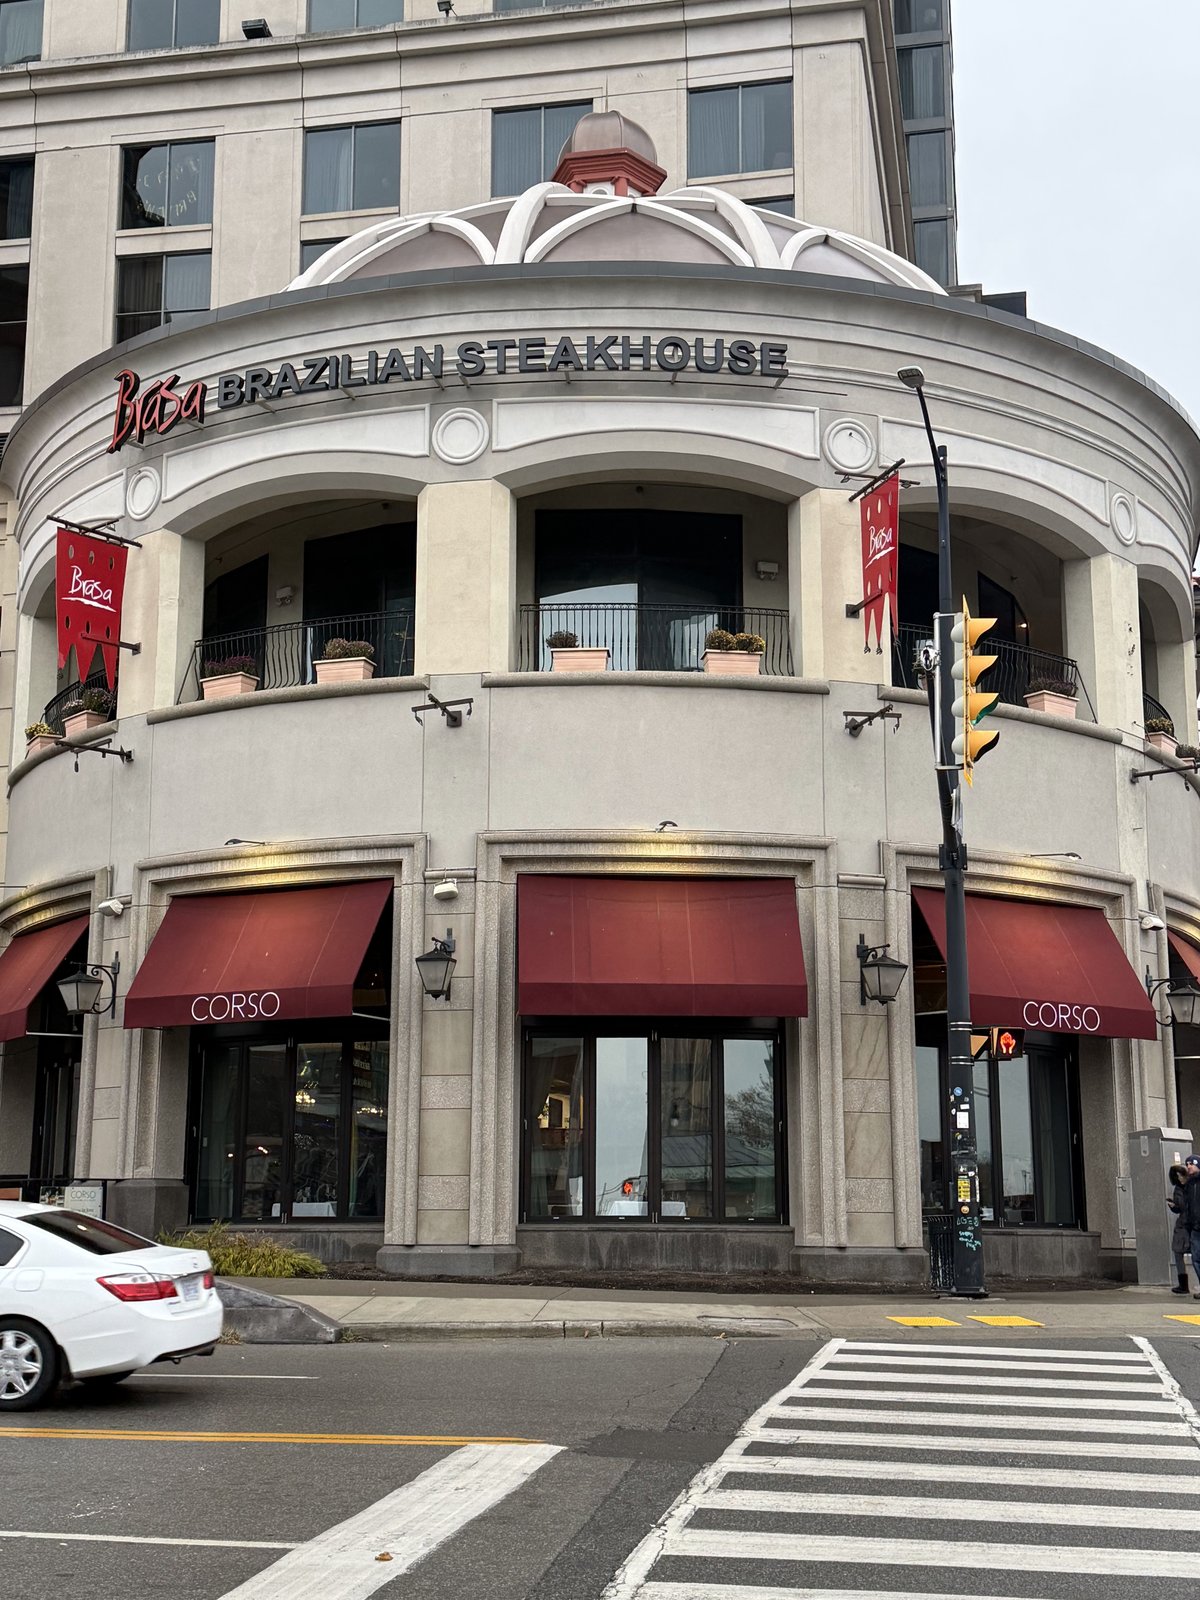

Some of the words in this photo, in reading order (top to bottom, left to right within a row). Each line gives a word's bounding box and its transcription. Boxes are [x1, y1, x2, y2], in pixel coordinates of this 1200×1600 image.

[107, 369, 207, 454] Brasa
[217, 343, 445, 409] BRAZILIAN
[456, 335, 789, 378] STEAKHOUSE
[868, 525, 893, 558] Brasa
[68, 565, 113, 605] Brasa
[191, 991, 280, 1021] CORSO
[1023, 1001, 1100, 1031] CORSO
[71, 1190, 97, 1199] CORSO
